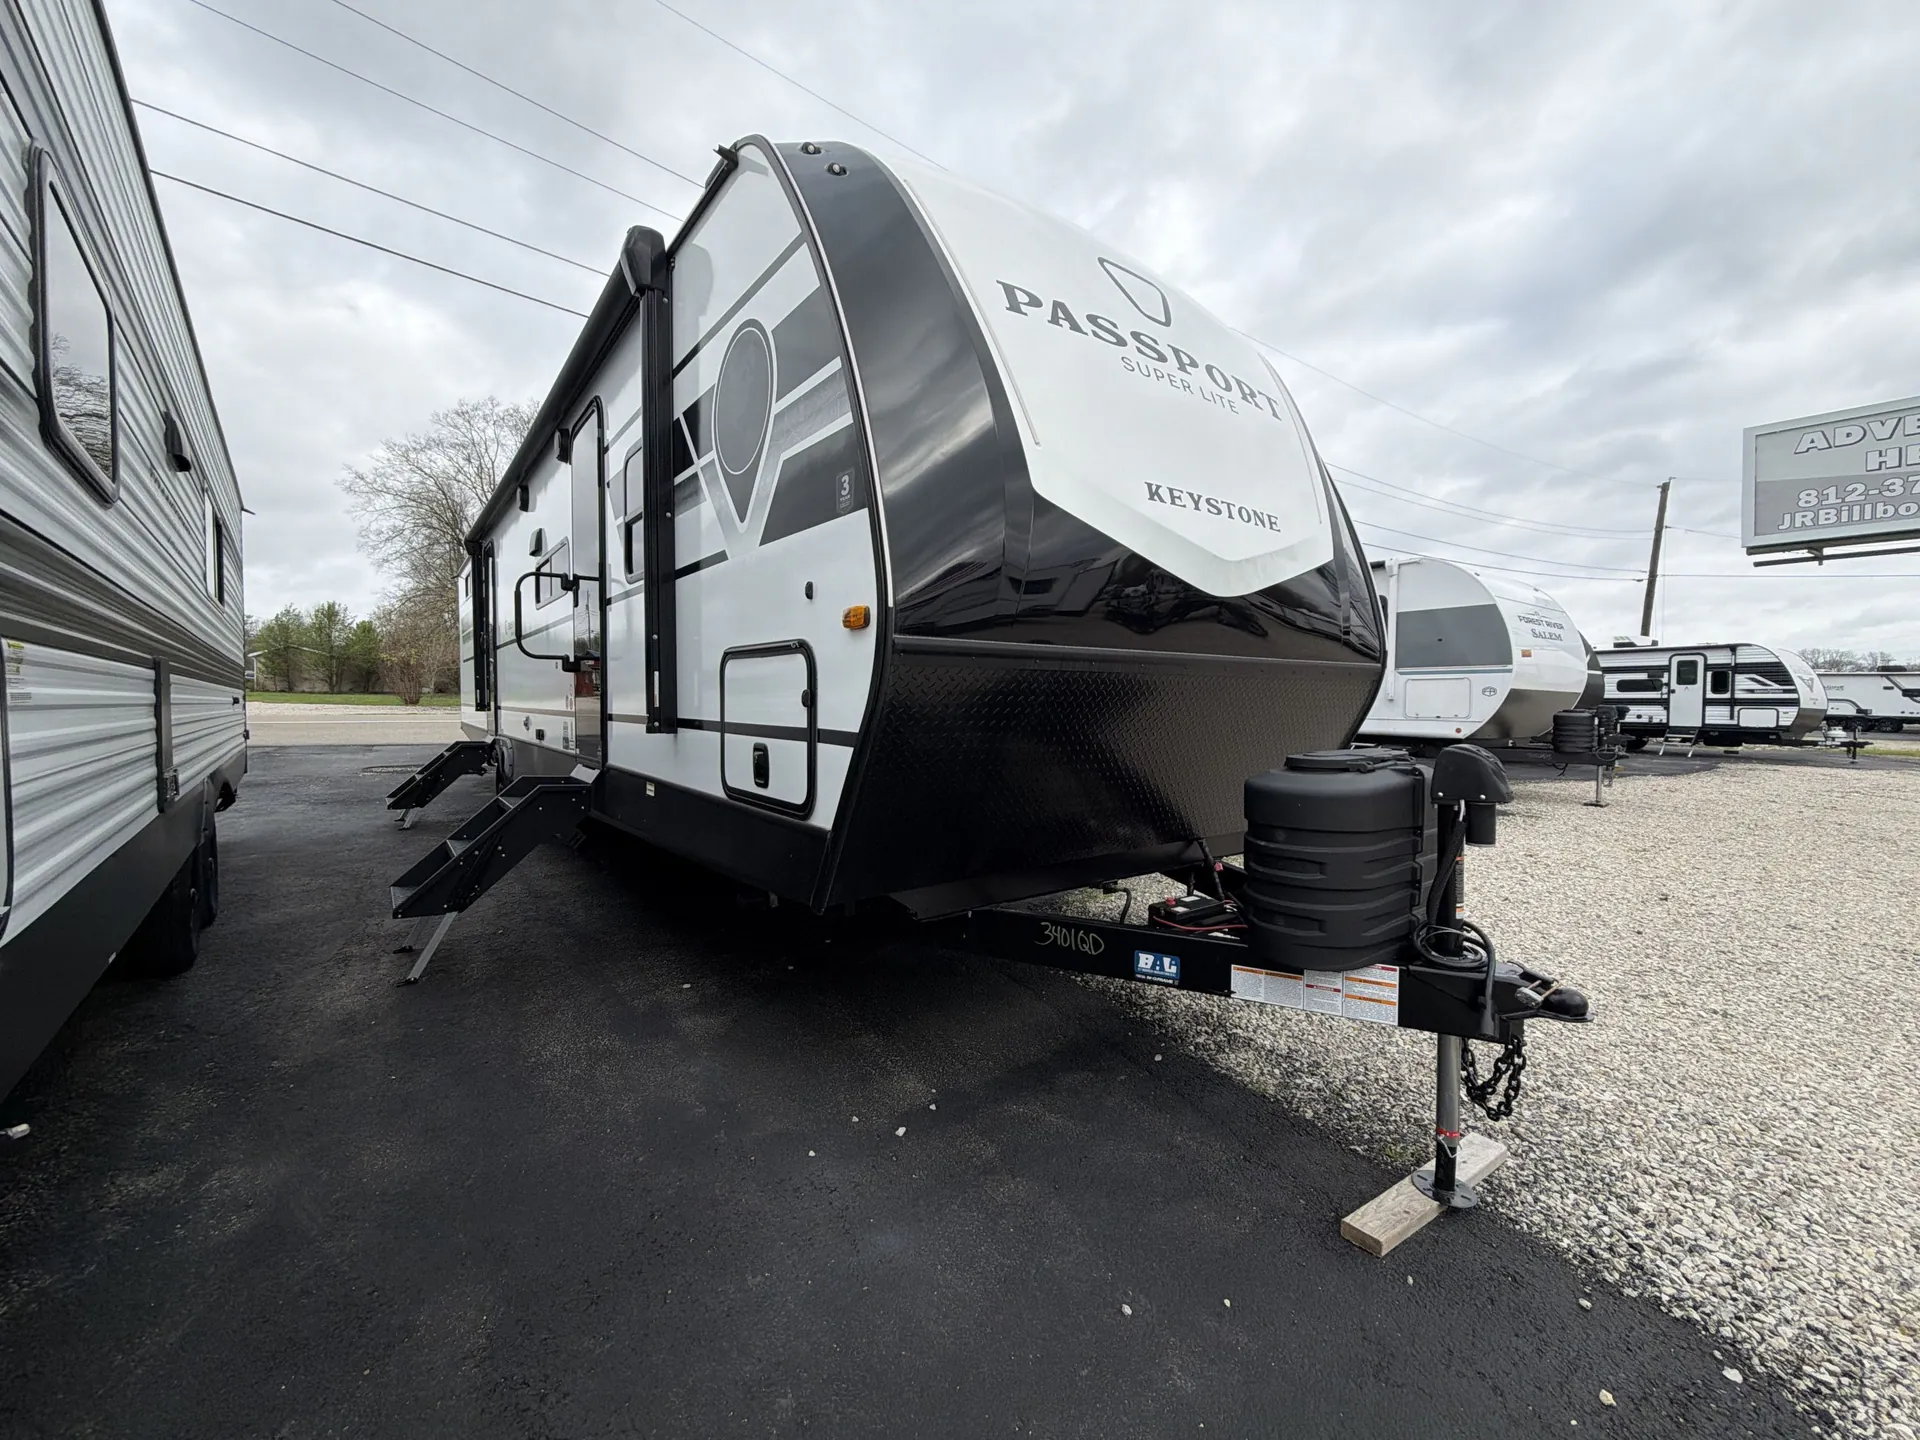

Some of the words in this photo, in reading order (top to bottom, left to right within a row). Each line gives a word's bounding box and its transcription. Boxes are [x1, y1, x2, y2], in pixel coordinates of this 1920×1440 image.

[996, 279, 1282, 421] PASSPORT
[1121, 356, 1194, 395] SUPER
[1199, 386, 1239, 415] LITE
[841, 475, 849, 495] 3
[1144, 481, 1281, 532] KEYSTONE
[1777, 501, 1920, 530] JRBillbo
[1517, 615, 1544, 626] FOREST
[1531, 628, 1563, 641] SALEM
